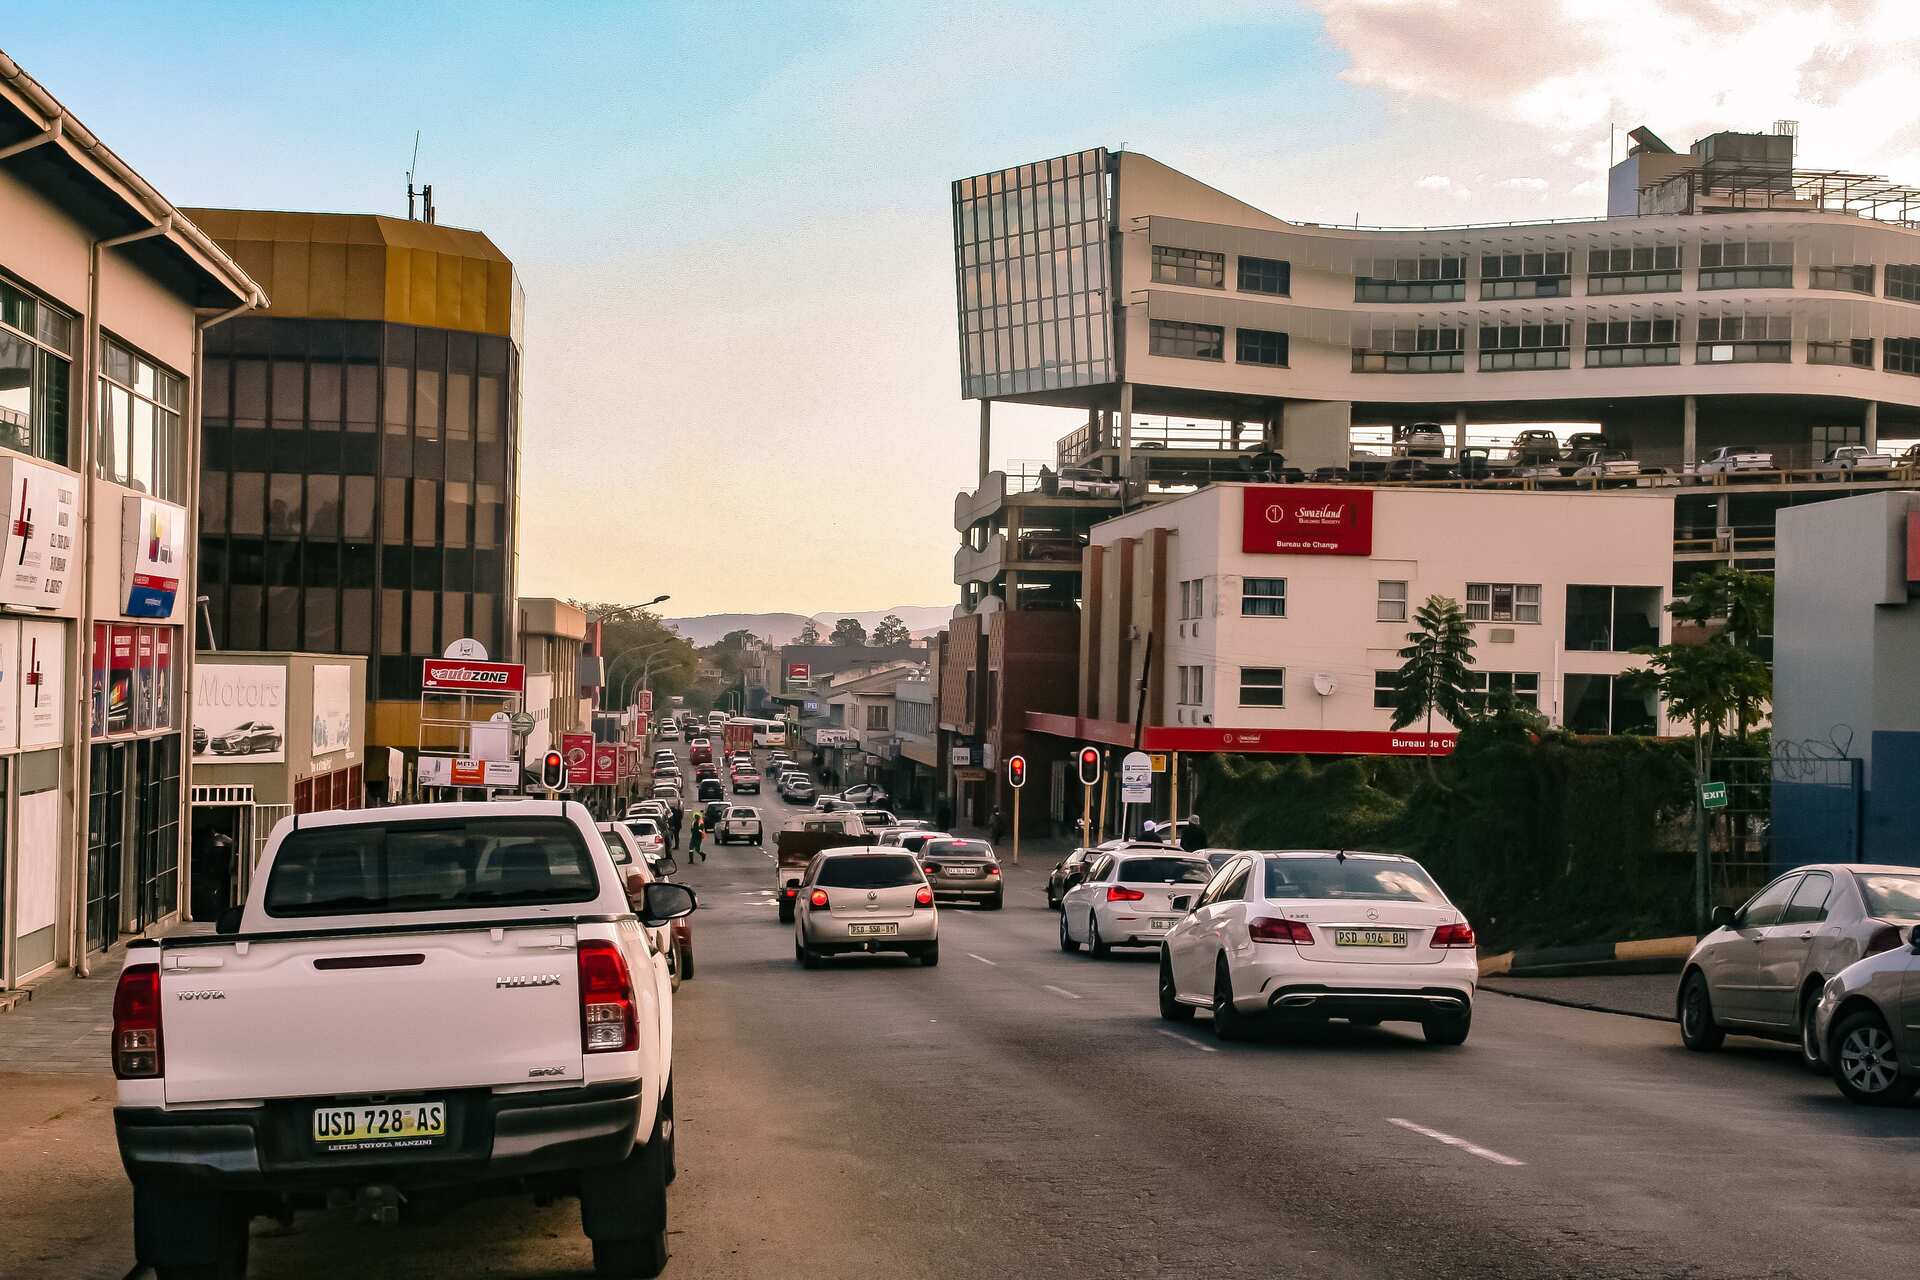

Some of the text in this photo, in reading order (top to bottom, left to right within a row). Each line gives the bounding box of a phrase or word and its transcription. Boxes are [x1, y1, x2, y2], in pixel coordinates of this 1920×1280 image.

[1295, 504, 1344, 518] Swaziland
[1276, 540, 1301, 548] Bureau
[1312, 541, 1338, 550] Change
[198, 673, 281, 707] Motors
[1392, 739, 1425, 748] Bureau
[1703, 791, 1725, 800] EXIT
[1339, 932, 1357, 943] PSD
[1365, 933, 1383, 943] 996
[496, 974, 561, 989] HILUX
[176, 990, 226, 1001] TOYOTA
[318, 1107, 441, 1136] USD 728 AS
[395, 1139, 432, 1147] MANZINI
